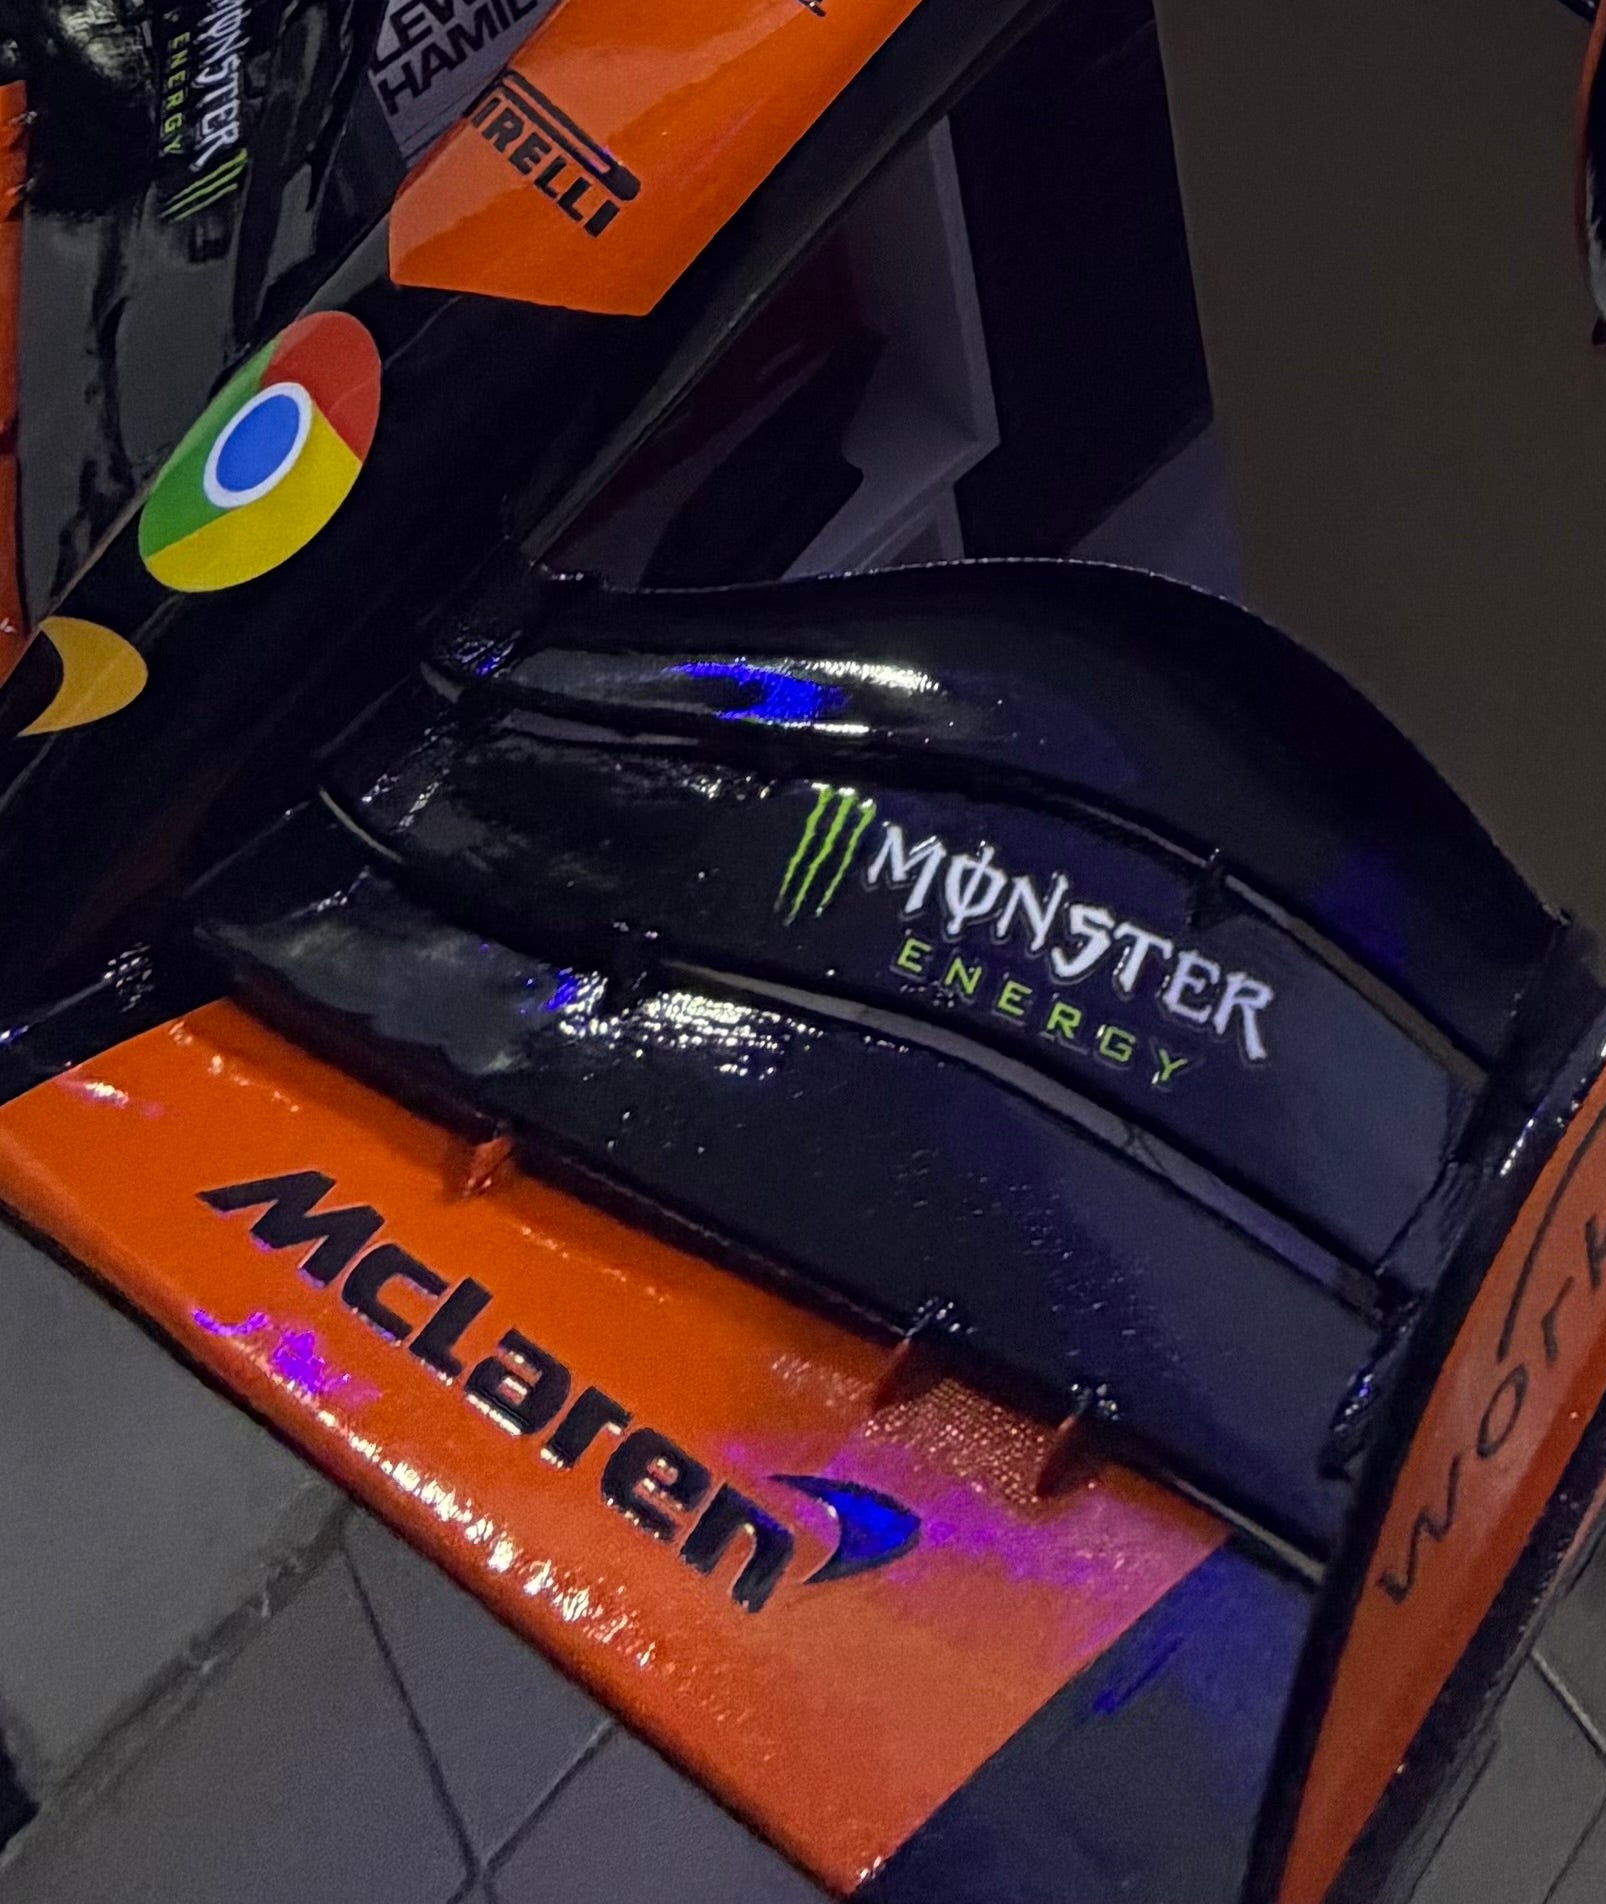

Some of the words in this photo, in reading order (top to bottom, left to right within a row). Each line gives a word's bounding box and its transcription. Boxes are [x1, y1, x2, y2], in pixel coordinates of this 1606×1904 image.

[163, 31, 191, 154] ENERGY
[866, 820, 1278, 1061] MONSTER
[896, 935, 1190, 1087] ENERGY
[195, 1169, 797, 1616] McLaren
